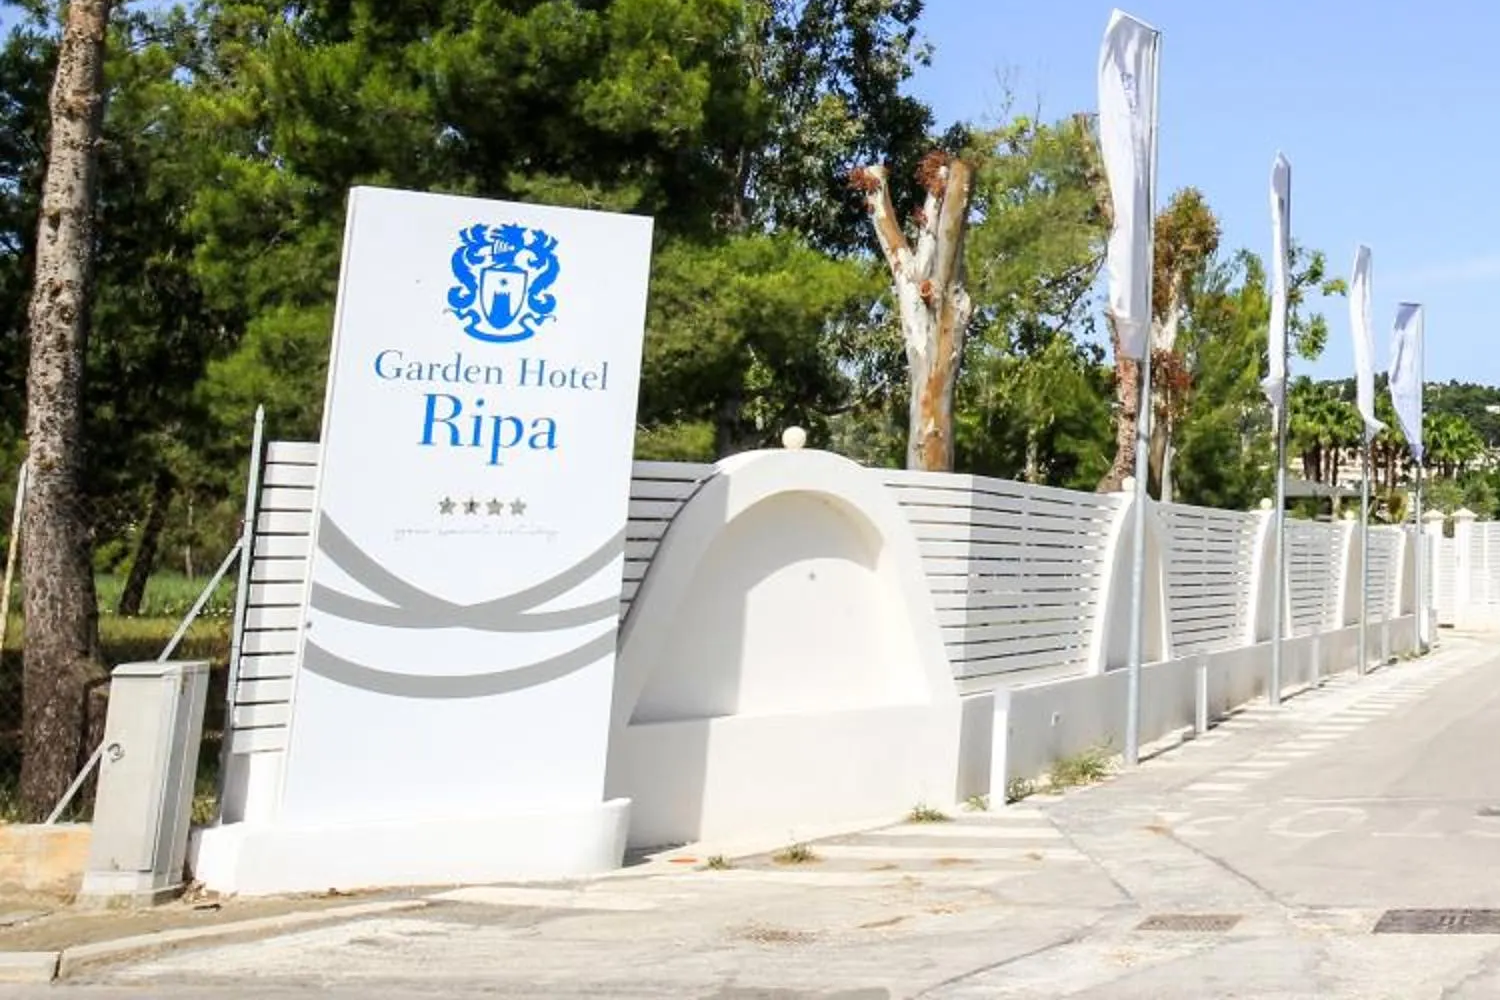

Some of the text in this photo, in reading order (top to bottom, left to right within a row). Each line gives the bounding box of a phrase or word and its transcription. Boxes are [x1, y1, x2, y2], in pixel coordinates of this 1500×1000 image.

[374, 348, 608, 391] Garden Hotel
[416, 392, 558, 467] Ripa
